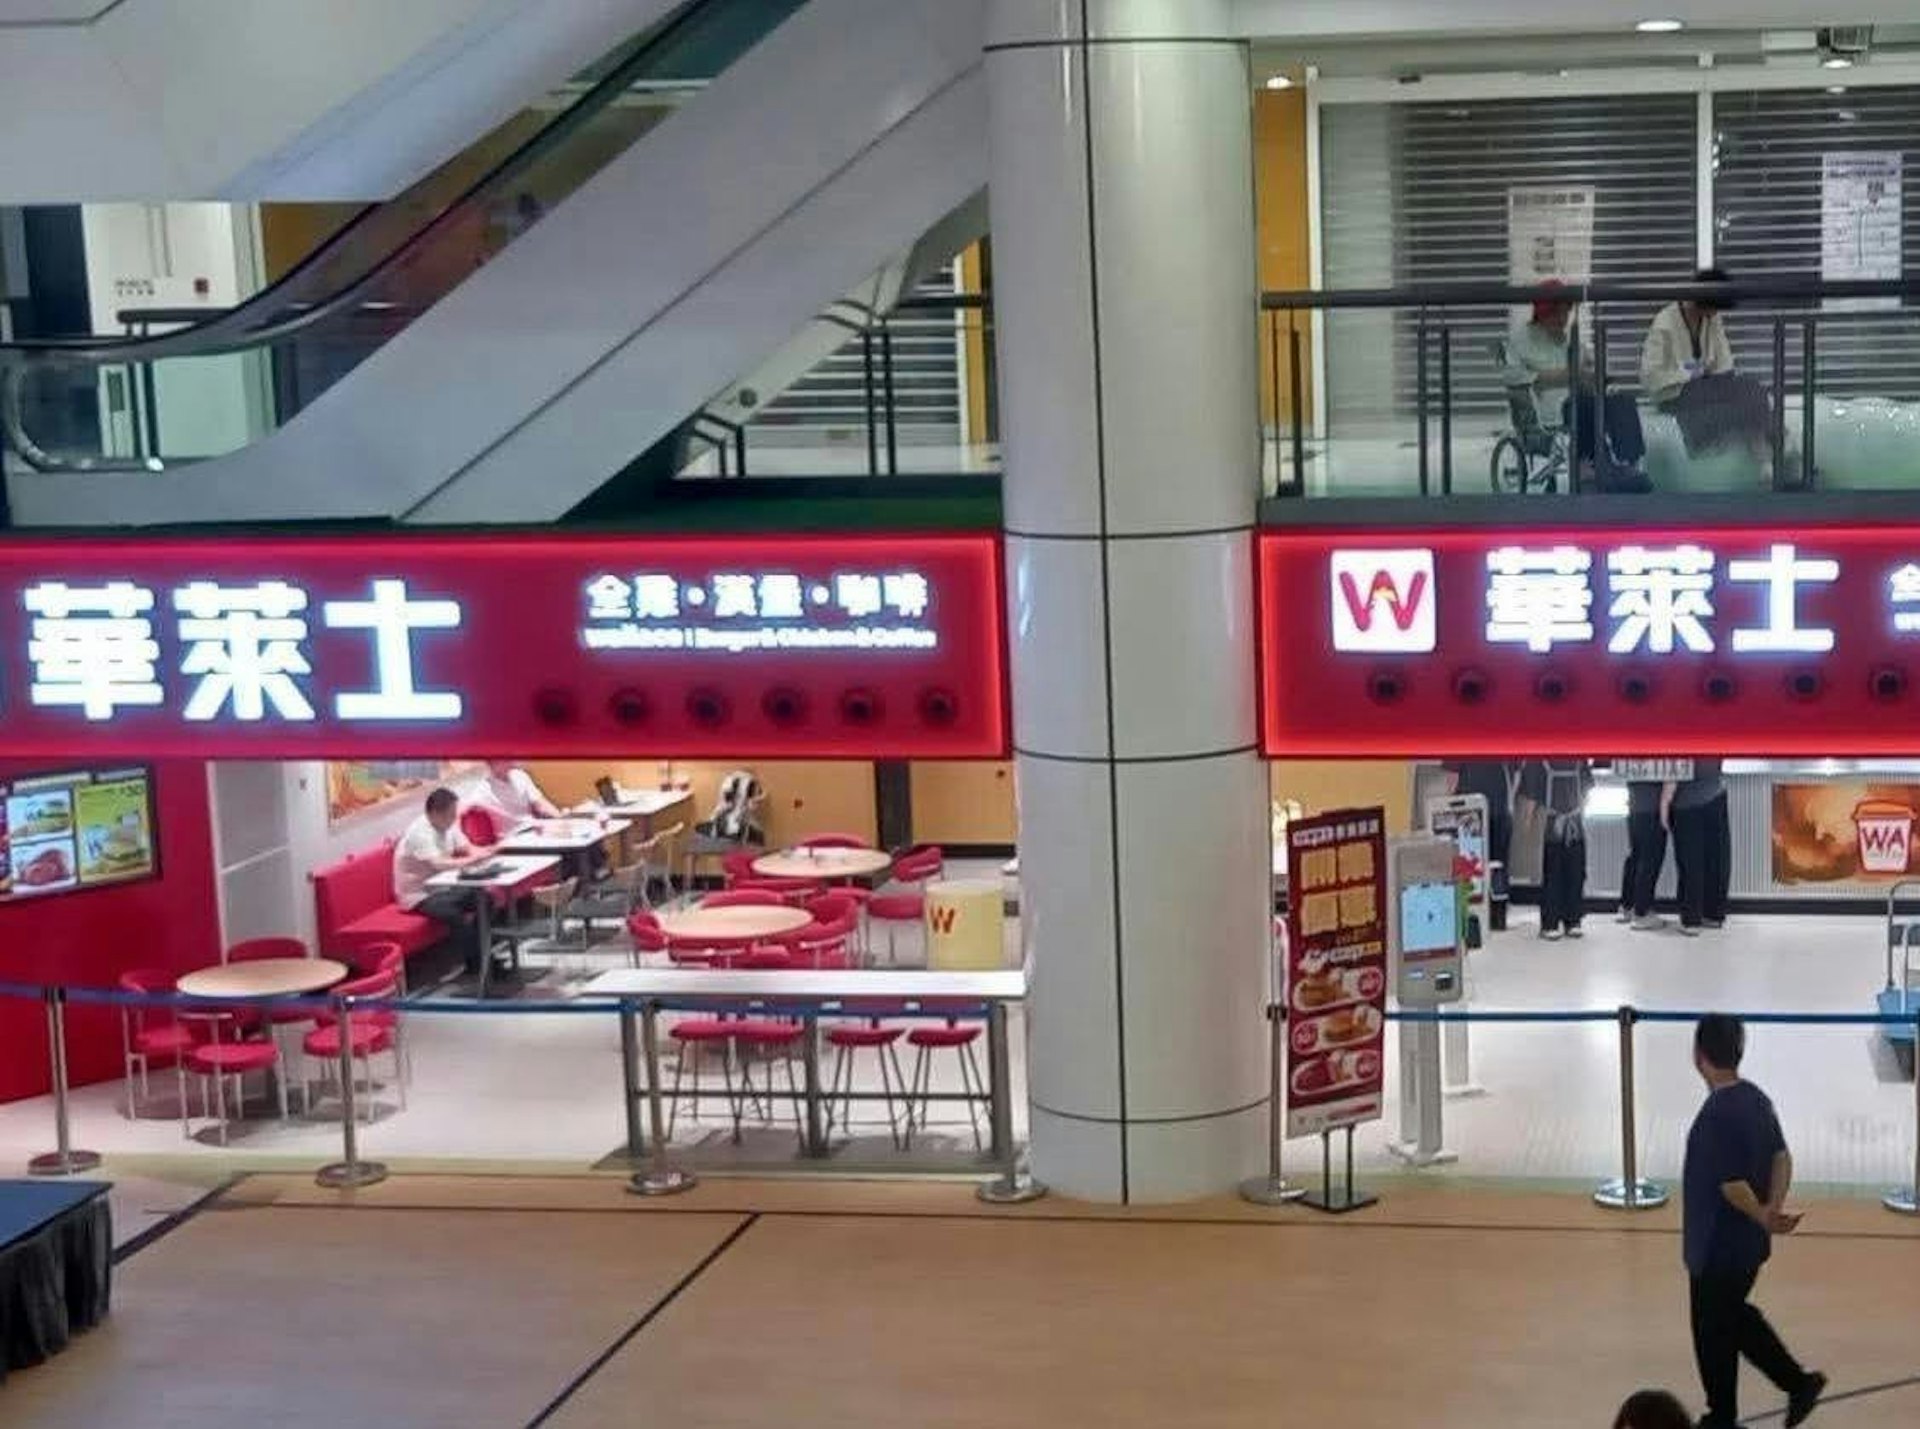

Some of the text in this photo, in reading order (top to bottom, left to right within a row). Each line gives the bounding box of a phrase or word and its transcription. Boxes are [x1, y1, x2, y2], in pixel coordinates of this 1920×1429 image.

[1339, 569, 1426, 632] W
[1485, 544, 1839, 653] 華萊士
[24, 579, 463, 721] 華萊士
[1861, 826, 1905, 851] WA
[929, 905, 955, 934] W
